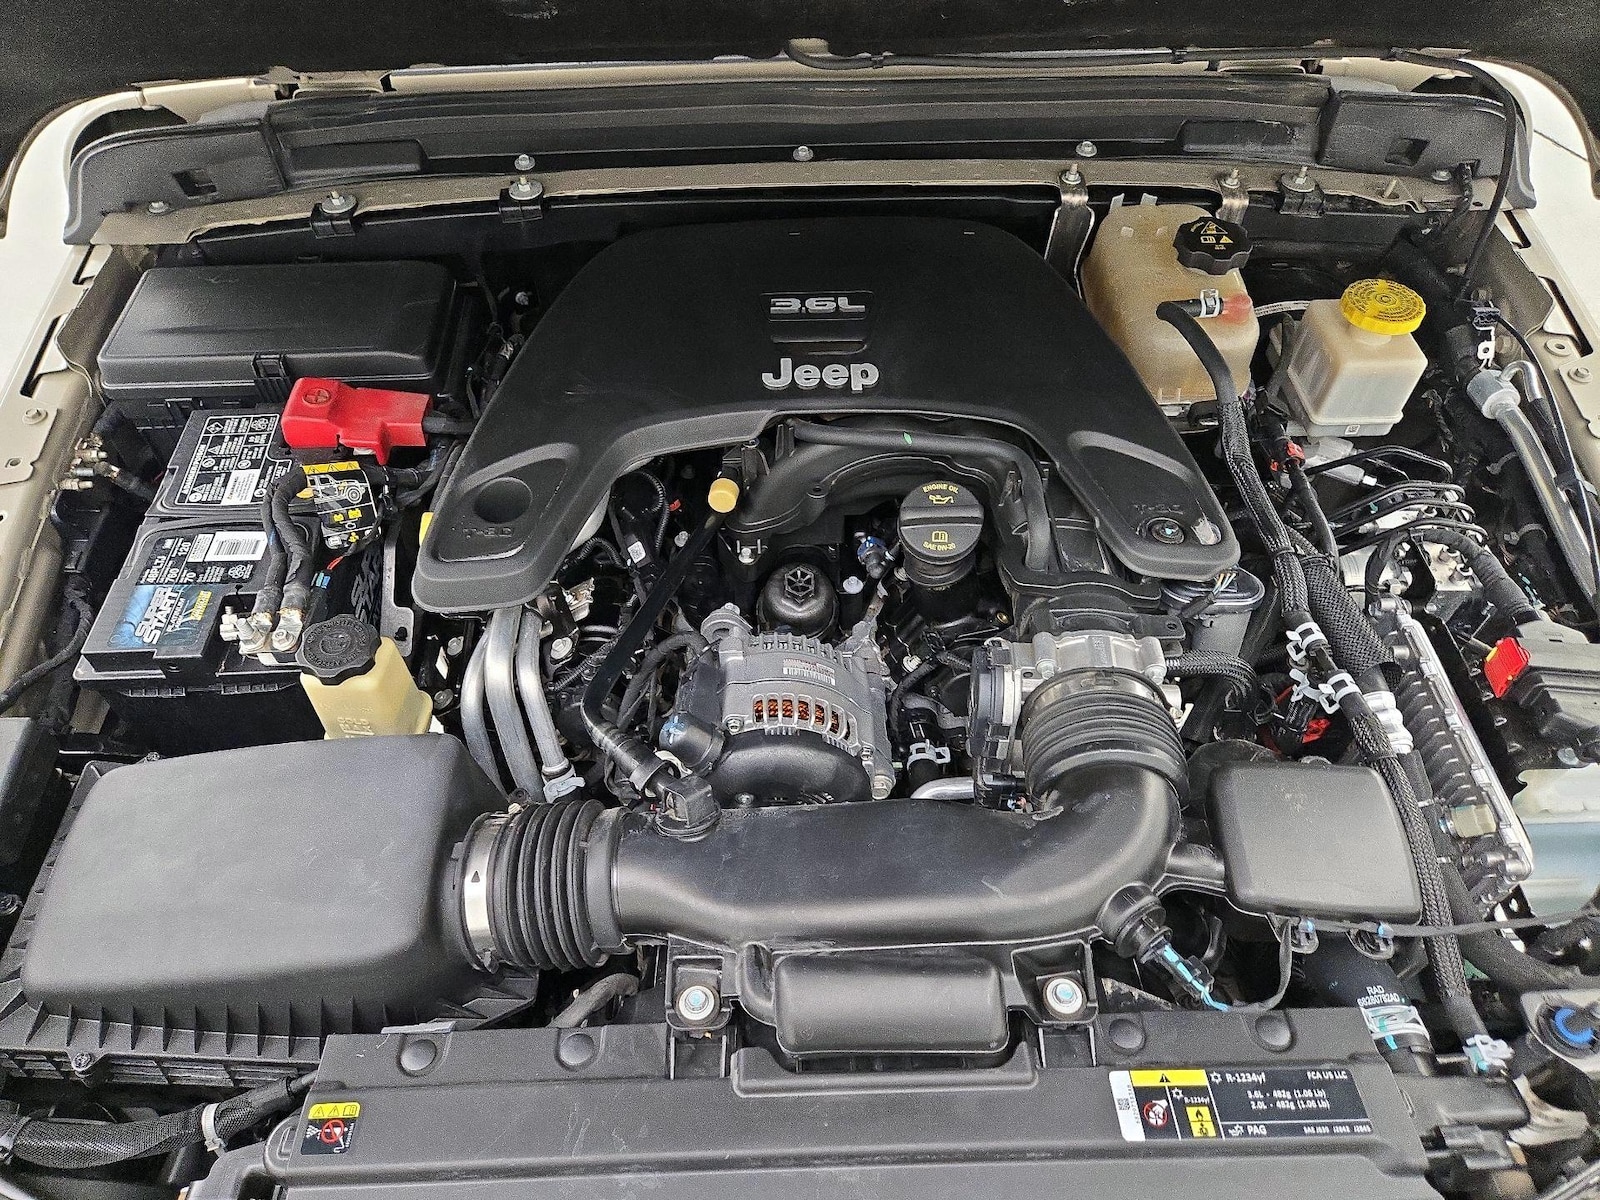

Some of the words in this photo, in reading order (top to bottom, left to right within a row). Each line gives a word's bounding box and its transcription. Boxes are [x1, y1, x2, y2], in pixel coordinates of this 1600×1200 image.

[770, 297, 865, 314] 3.6L
[762, 358, 879, 392] Jeep
[922, 483, 948, 493] ENGINE
[948, 485, 959, 494] OIL
[178, 541, 191, 556] 120
[923, 541, 937, 551] SAE
[937, 542, 956, 551] 0W-20
[164, 567, 179, 584] 760
[135, 586, 169, 637] SUPER
[142, 587, 179, 644] START
[1366, 985, 1385, 995] RAD
[1225, 1072, 1266, 1084] R-1234yf
[1306, 1071, 1322, 1080] FCA
[1322, 1071, 1334, 1079] US
[1334, 1070, 1348, 1079] LLC
[1250, 1101, 1267, 1110] 2.0L
[1246, 1125, 1267, 1135] PAG
